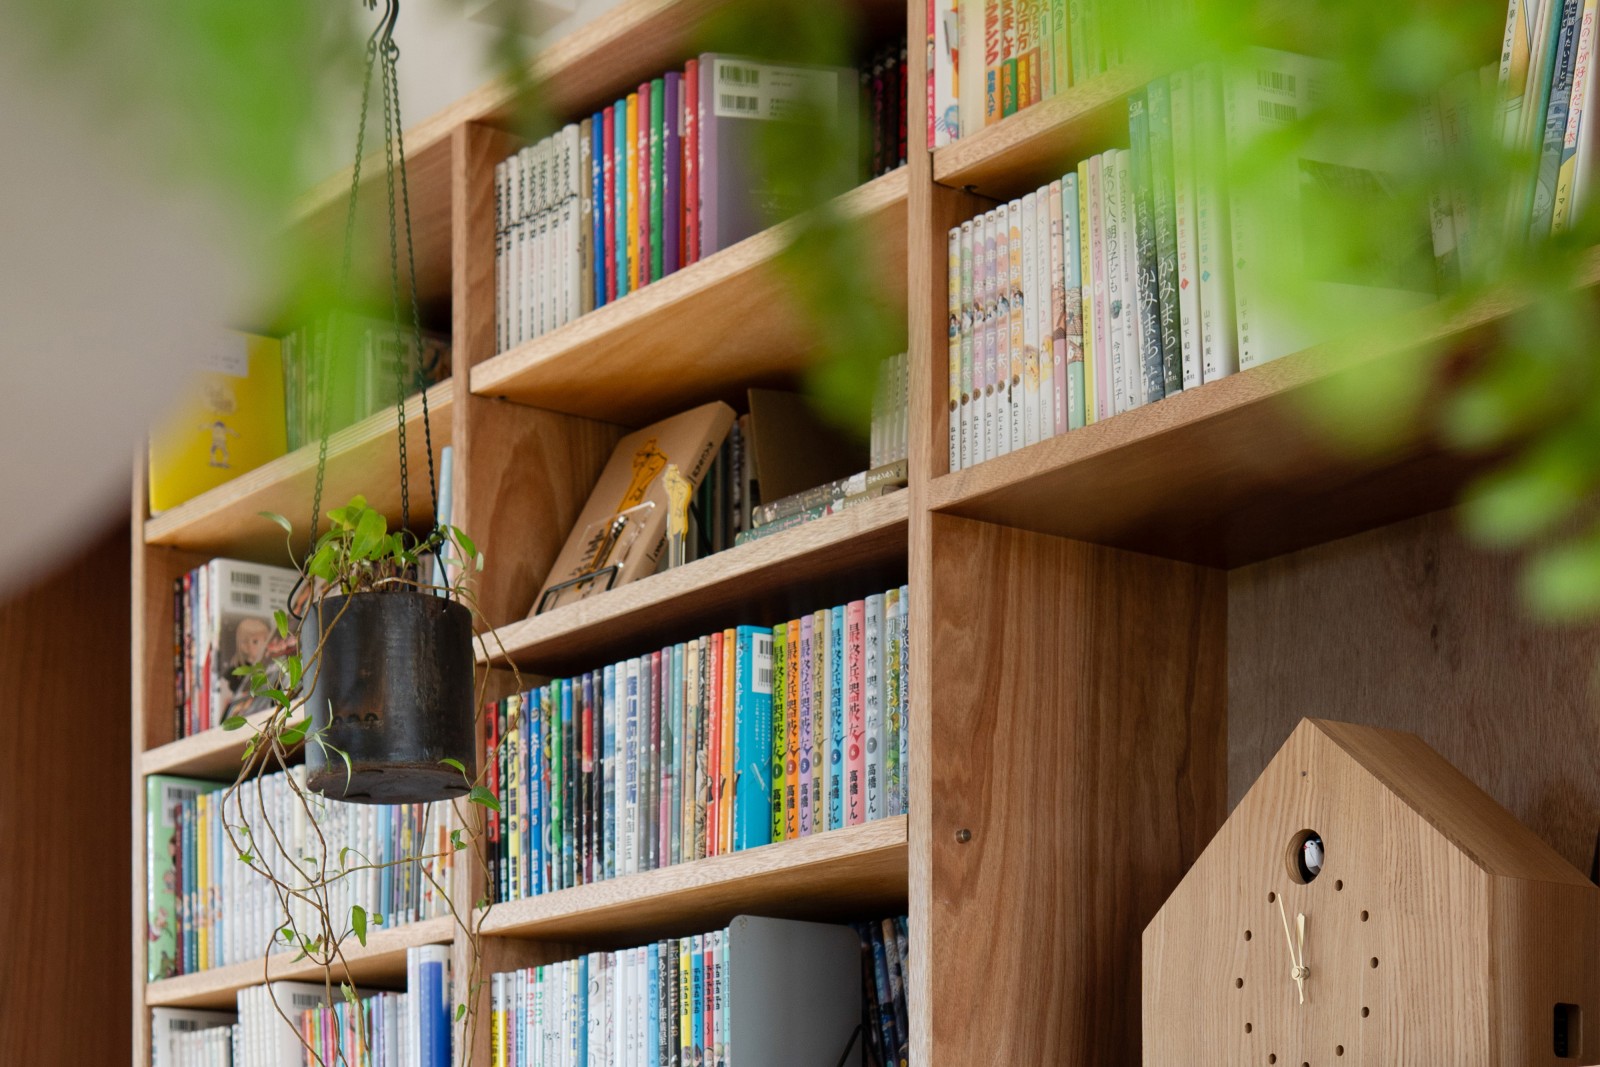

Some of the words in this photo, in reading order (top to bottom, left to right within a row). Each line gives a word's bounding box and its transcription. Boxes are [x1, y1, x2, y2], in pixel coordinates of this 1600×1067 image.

[849, 622, 866, 743] 最終兵器彼女
